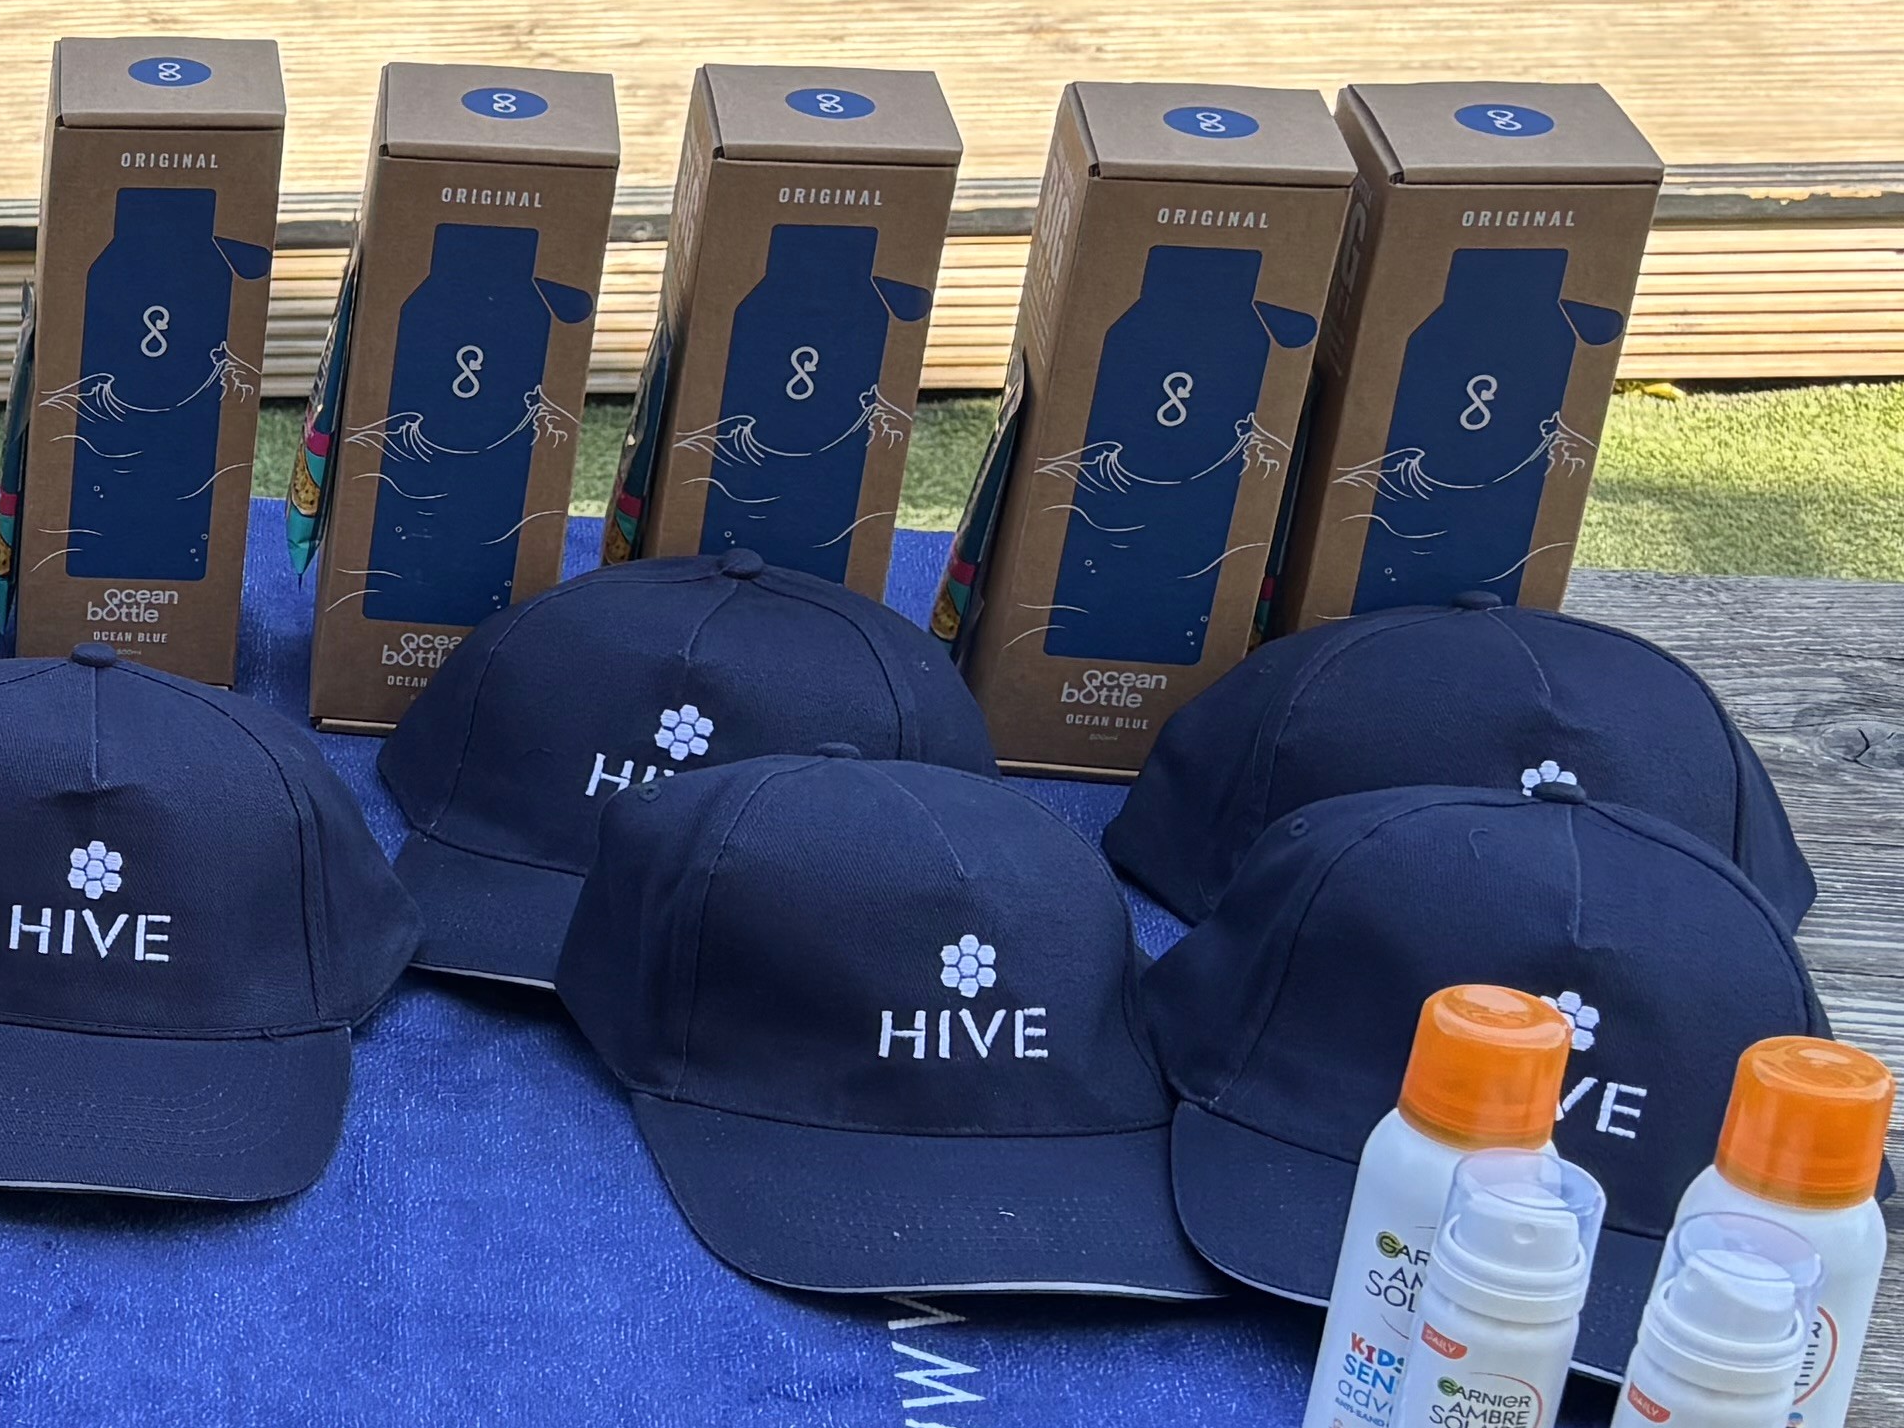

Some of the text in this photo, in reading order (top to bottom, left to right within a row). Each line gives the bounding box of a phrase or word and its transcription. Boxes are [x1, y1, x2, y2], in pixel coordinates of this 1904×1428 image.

[120, 152, 219, 169] ORIGINAL
[441, 187, 543, 208] ORIGINAL
[778, 187, 883, 206] ORIGINAL
[1157, 207, 1269, 228] ORIGINAL
[1461, 210, 1576, 227] ORIGINAL
[104, 589, 179, 605] ocean
[87, 601, 159, 623] bottle
[93, 631, 168, 643] OCEAN BLUE
[400, 633, 462, 650] ocea
[381, 644, 448, 668] bottl
[387, 675, 428, 687] OCEAN
[1083, 670, 1167, 689] ocean
[1060, 682, 1142, 708] bottle
[1066, 714, 1149, 729] OCEAN BLUE
[9, 904, 172, 963] HIVE
[878, 1007, 1049, 1060] HIVE
[1449, 1402, 1530, 1425] AMBRE
